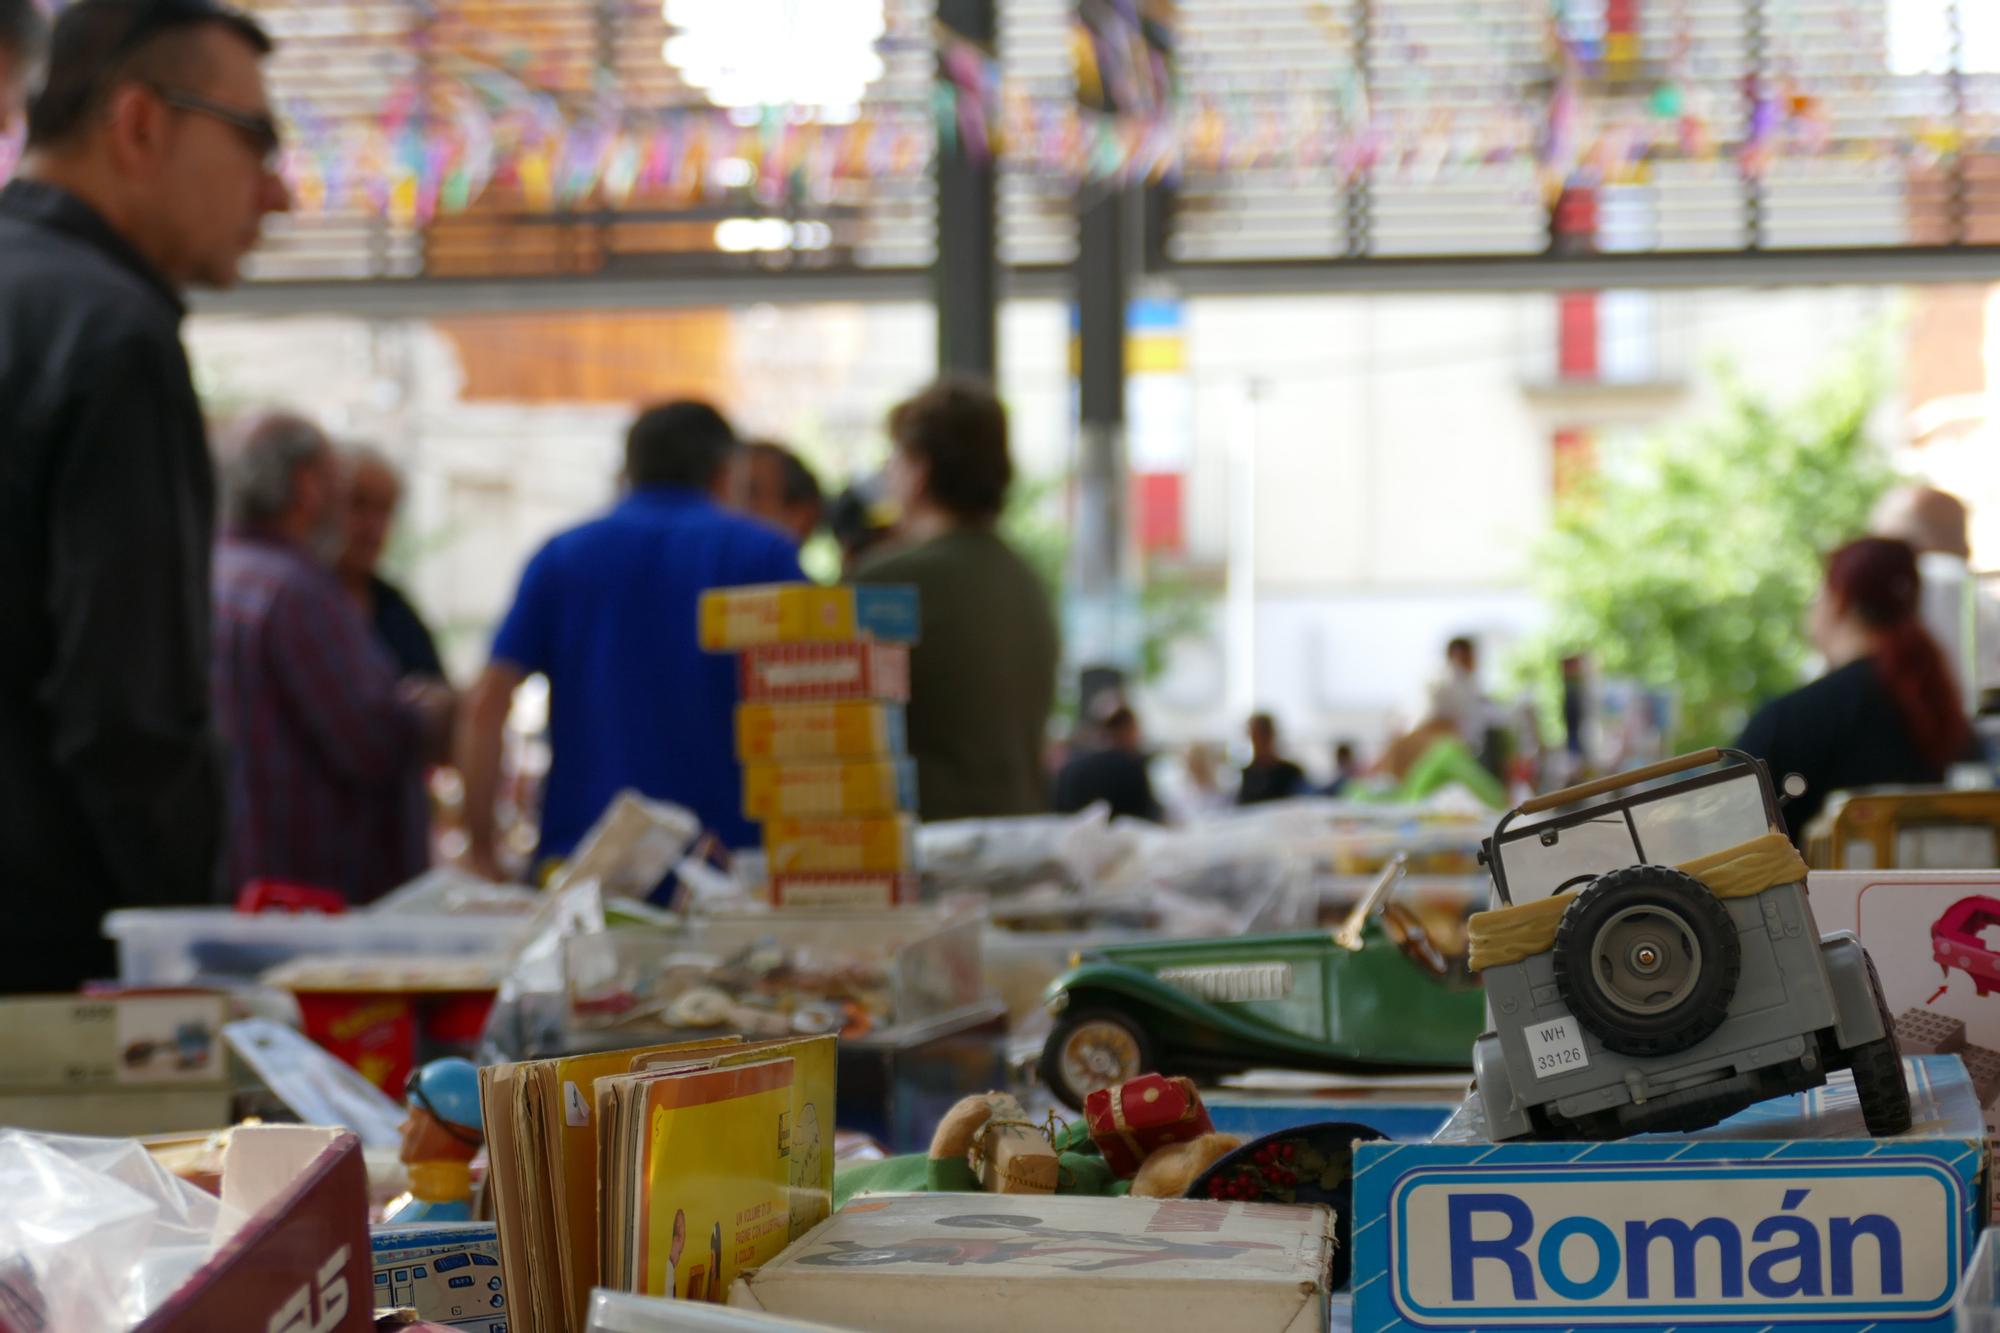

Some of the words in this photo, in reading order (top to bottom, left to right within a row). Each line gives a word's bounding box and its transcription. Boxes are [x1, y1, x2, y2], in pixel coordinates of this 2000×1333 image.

[1540, 1025, 1566, 1043] WH
[1538, 1047, 1581, 1070] 33126
[1448, 1189, 1904, 1301] Román
